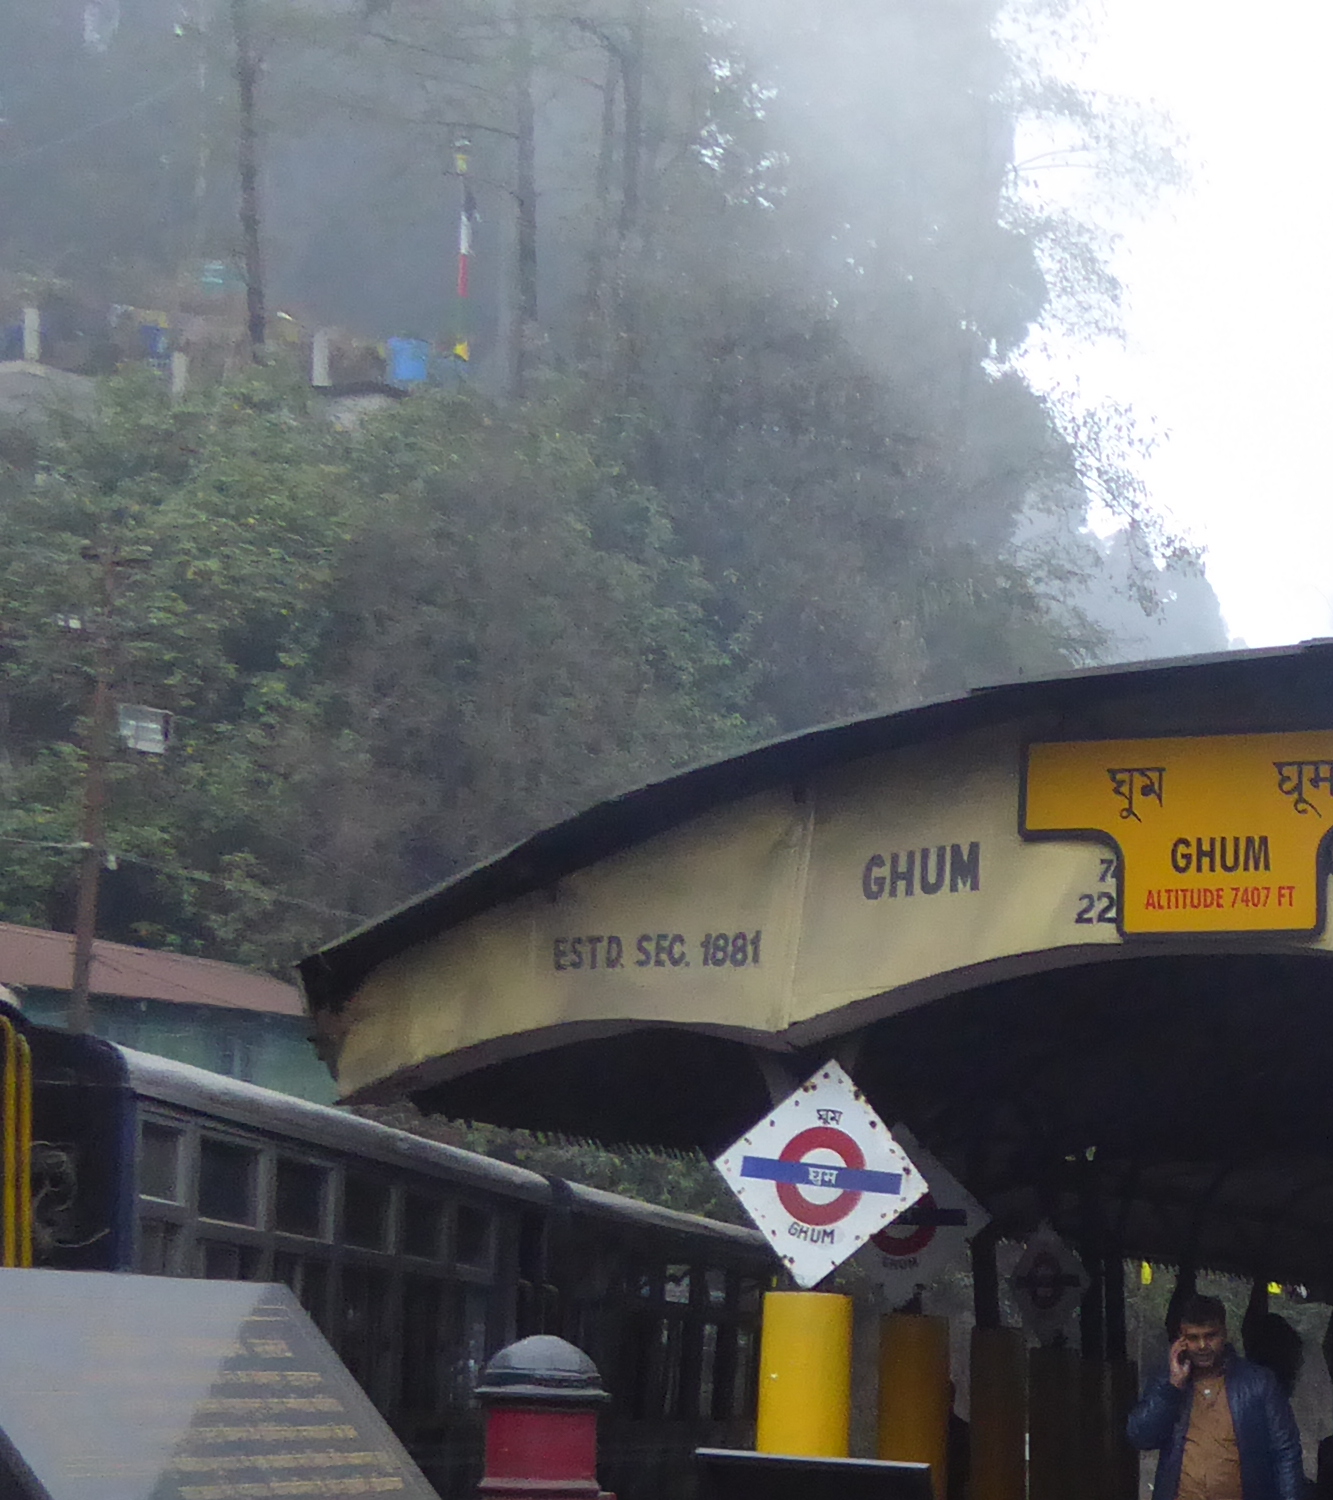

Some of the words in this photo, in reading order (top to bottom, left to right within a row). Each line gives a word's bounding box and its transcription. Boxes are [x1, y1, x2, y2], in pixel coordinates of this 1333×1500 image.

[1107, 767, 1166, 823] ঘুম
[862, 841, 981, 900] GHUM
[1171, 836, 1271, 874] GHUM
[1145, 888, 1225, 910] ALTITUDE
[1230, 886, 1271, 909] 7407
[1277, 885, 1296, 908] FT
[700, 930, 762, 967] 1881
[787, 1221, 836, 1244] GHUM
